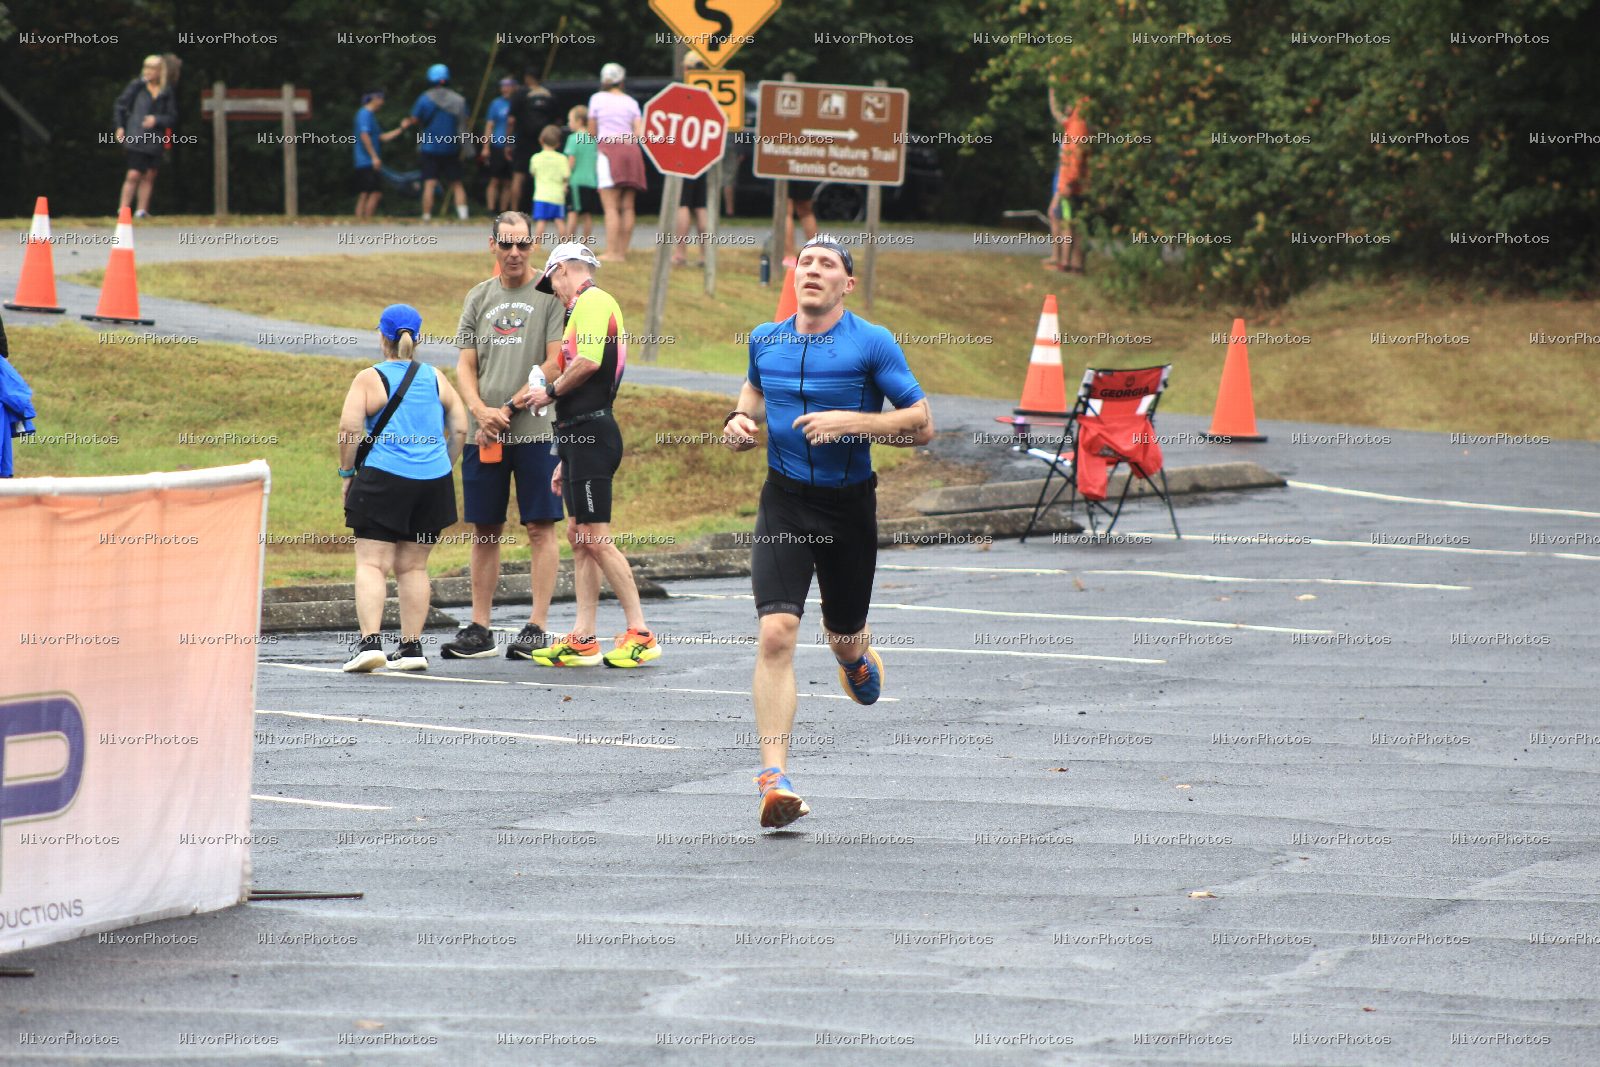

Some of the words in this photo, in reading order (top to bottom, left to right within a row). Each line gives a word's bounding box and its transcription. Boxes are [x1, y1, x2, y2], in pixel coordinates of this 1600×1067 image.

[649, 110, 721, 150] STOP
[871, 147, 897, 162] Trail
[787, 159, 827, 175] Tennis
[828, 162, 869, 178] Courts
[485, 305, 500, 319] OUT
[500, 302, 510, 310] OF
[511, 302, 535, 314] OFFICE
[1100, 385, 1150, 398] GEORGIA
